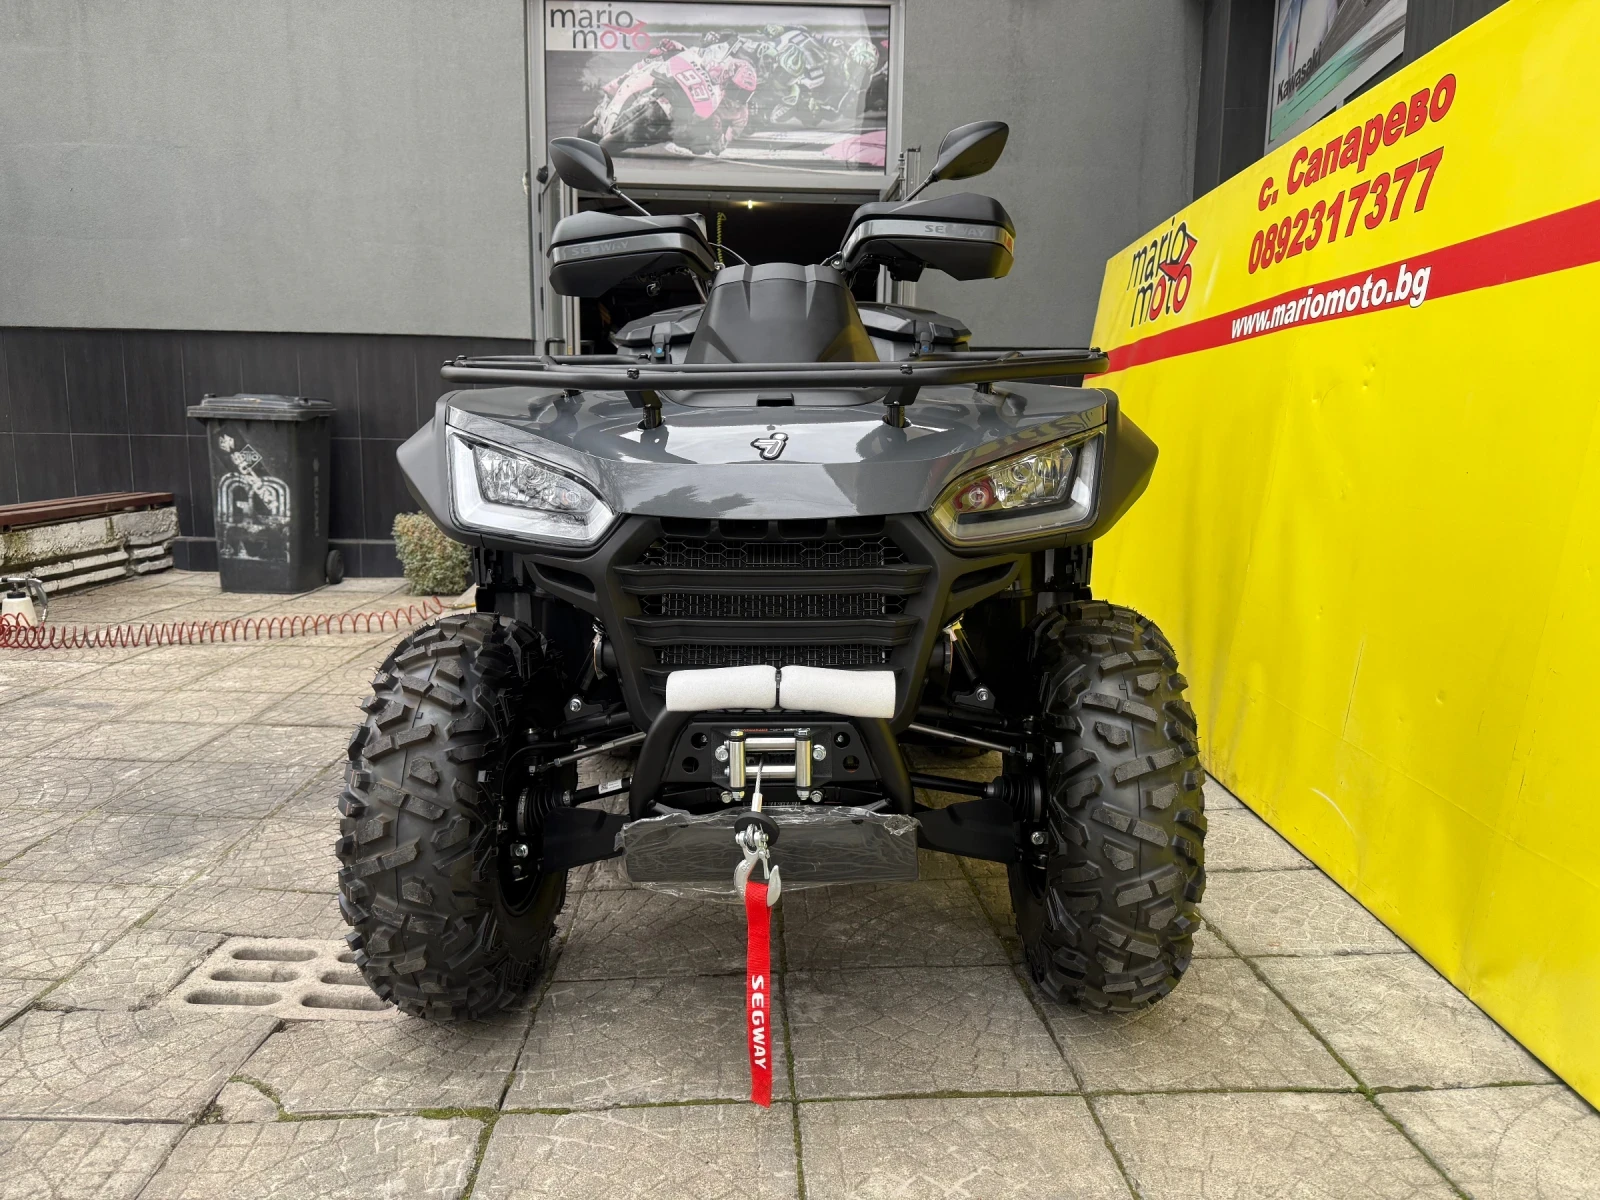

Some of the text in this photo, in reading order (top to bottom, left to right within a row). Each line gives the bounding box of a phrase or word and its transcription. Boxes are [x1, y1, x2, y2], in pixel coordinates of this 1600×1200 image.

[550, 3, 634, 29] mario
[572, 30, 651, 51] moto
[1276, 41, 1323, 106] Kawasaki
[1258, 73, 1457, 212] с. Сапарево
[924, 224, 986, 238] SEWAY
[1248, 146, 1445, 275] 0892317377
[1126, 216, 1187, 292] mario
[1130, 263, 1193, 328] moto
[1231, 263, 1432, 339] www.mariomoto.bg
[751, 974, 767, 1070] SEGWAY
